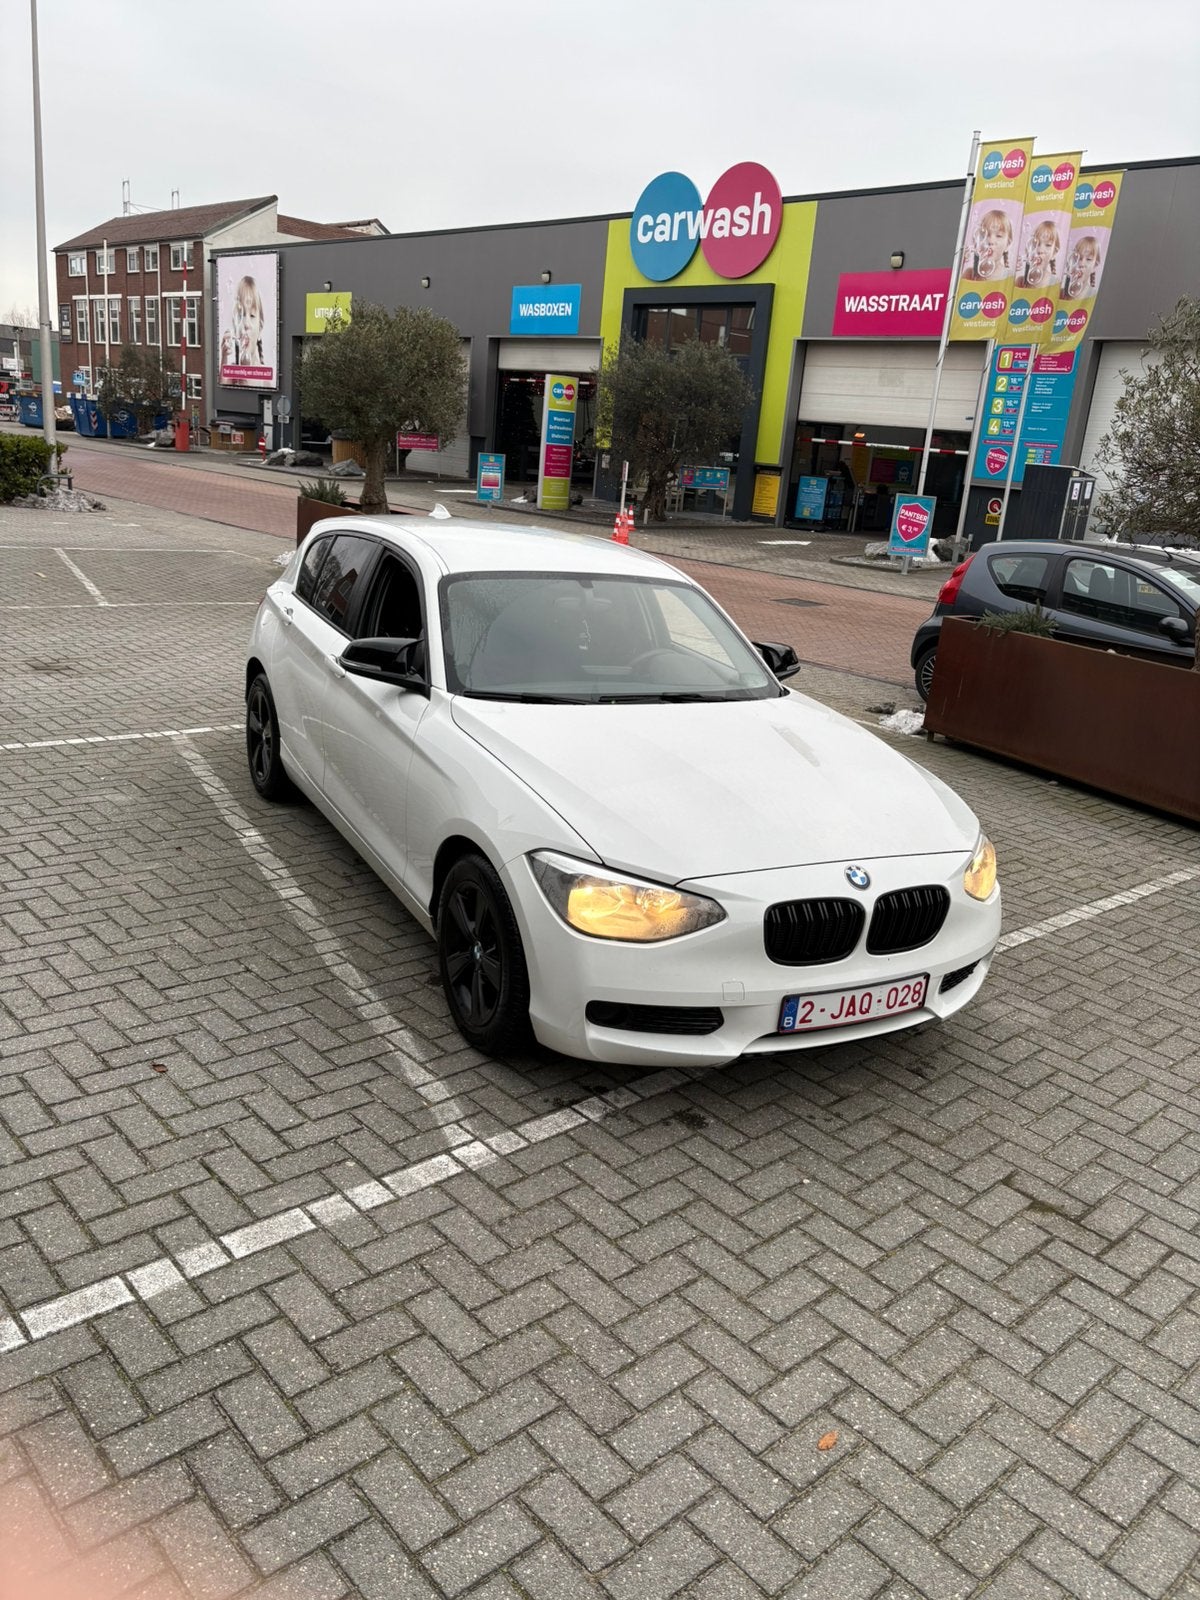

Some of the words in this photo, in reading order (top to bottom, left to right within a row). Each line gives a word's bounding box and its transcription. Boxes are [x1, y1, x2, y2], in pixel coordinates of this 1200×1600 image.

[984, 155, 1024, 171] carwash
[1032, 169, 1073, 184] carwash
[984, 180, 1015, 189] westland
[1036, 192, 1064, 202] westland
[1074, 187, 1114, 201] carwash
[637, 191, 772, 244] carwash
[1076, 209, 1105, 218] westland
[519, 302, 572, 317] WASBOXEN
[844, 293, 944, 313] WASSTRAAT
[960, 298, 1005, 311] carwash
[1009, 304, 1051, 316] carwash
[963, 320, 996, 328] westland
[1054, 315, 1086, 326] arwash
[1012, 325, 1043, 333] westland
[1003, 353, 1010, 366] 1
[997, 377, 1007, 391] 2
[993, 399, 1004, 413] 3
[990, 420, 999, 433] 4
[900, 508, 928, 522] PANTSER
[799, 981, 923, 1024] 2-JAQ-028
[783, 1016, 794, 1028] B
